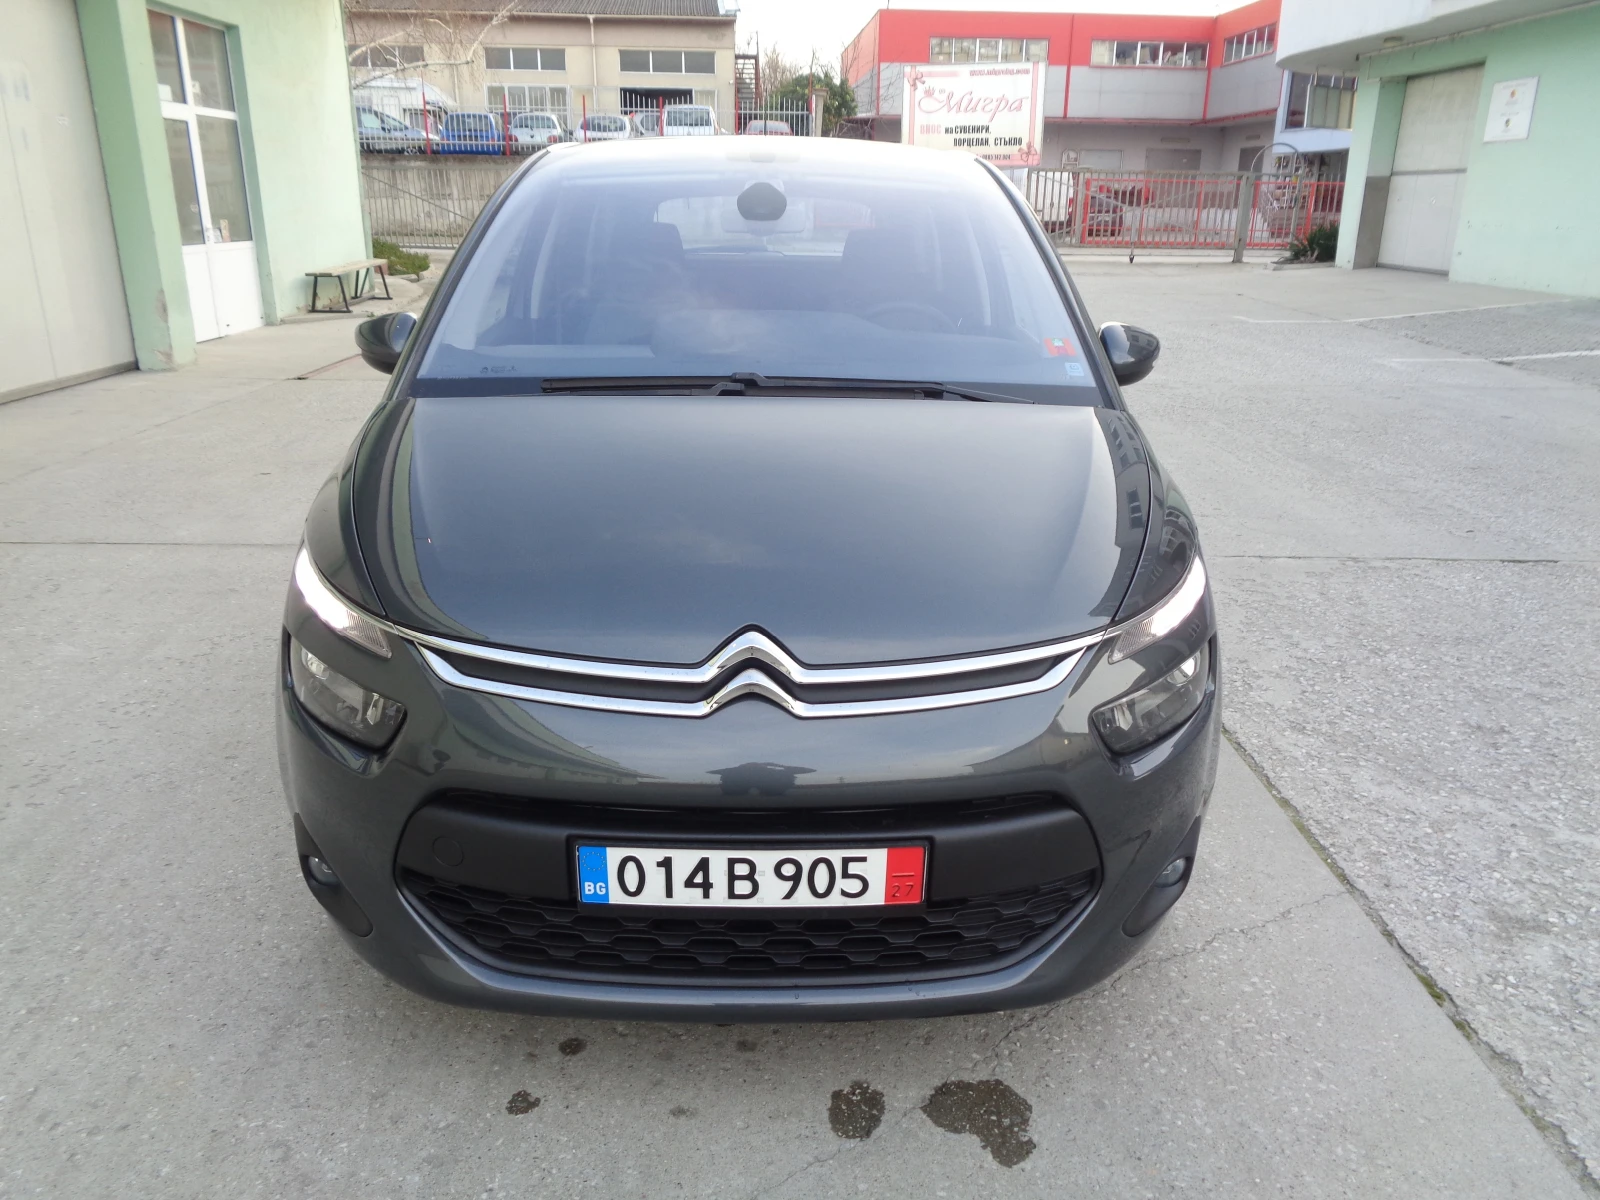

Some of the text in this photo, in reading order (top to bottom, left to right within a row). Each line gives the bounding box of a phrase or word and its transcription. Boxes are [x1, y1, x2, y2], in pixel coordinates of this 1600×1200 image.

[918, 91, 1029, 123] Мигра
[945, 126, 953, 135] на
[954, 124, 992, 135] СУВЕНИРИ,
[953, 136, 1023, 148] ПОРЦЕЛАН, СТЪКЛО
[584, 881, 606, 895] BG
[892, 882, 914, 898] 27
